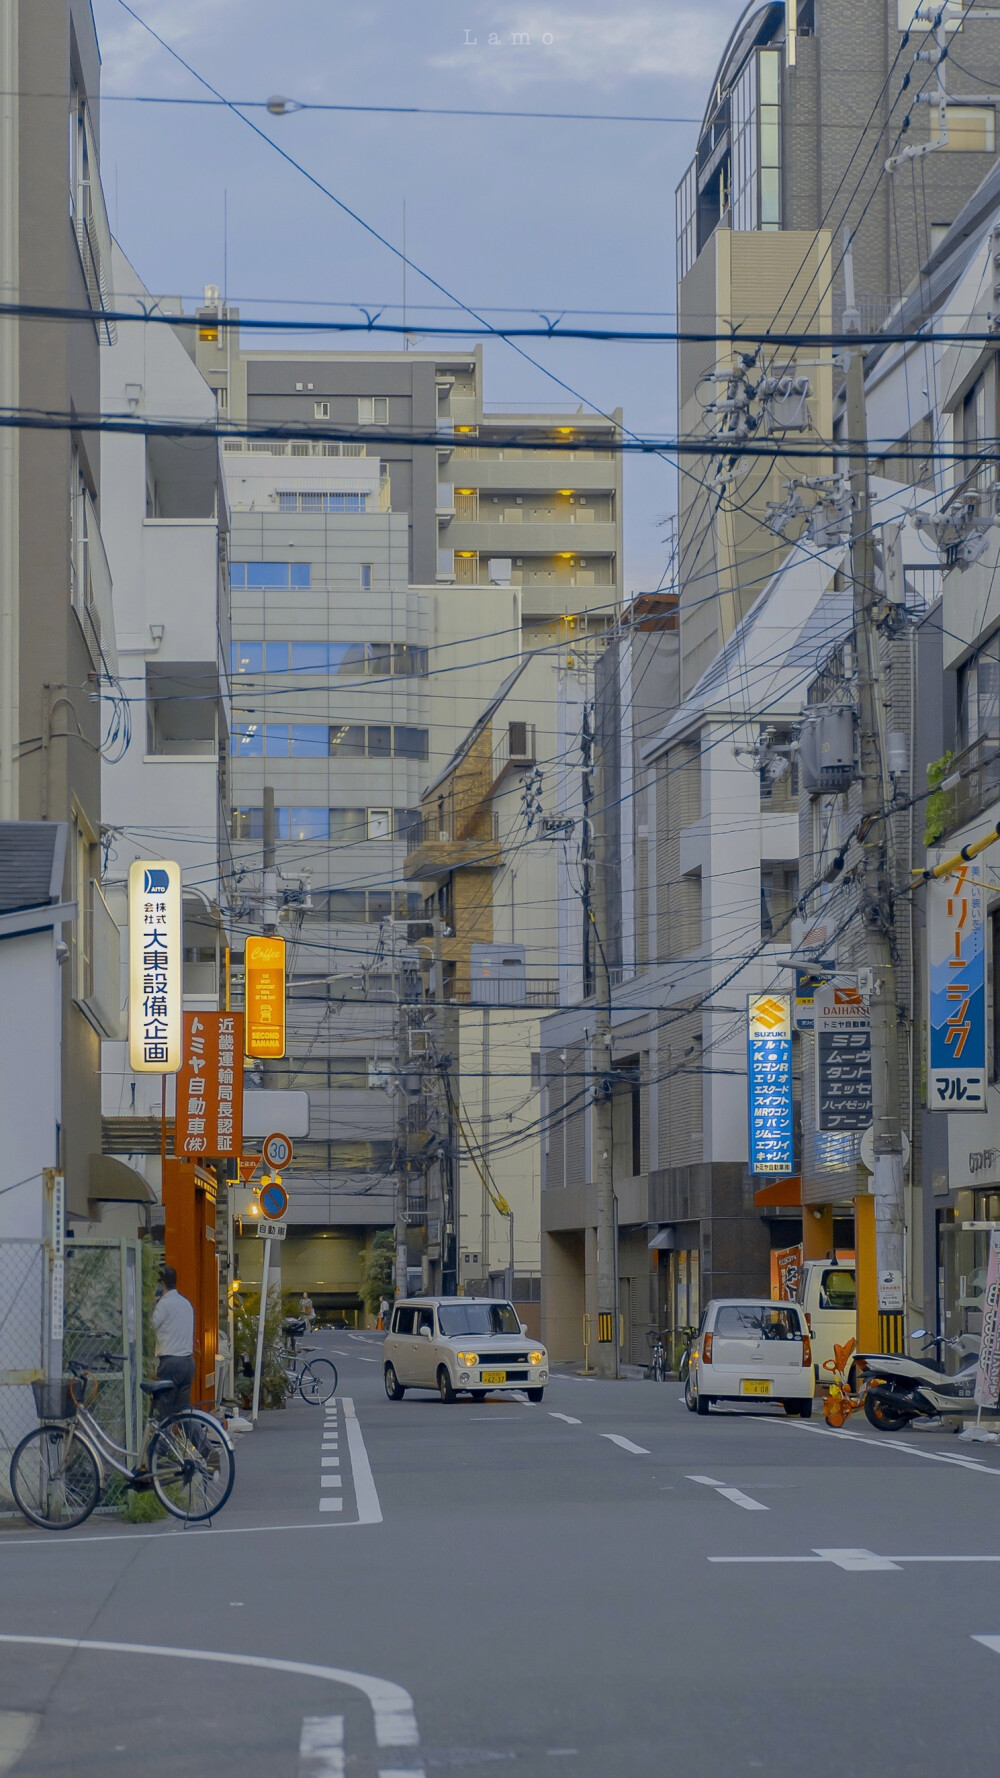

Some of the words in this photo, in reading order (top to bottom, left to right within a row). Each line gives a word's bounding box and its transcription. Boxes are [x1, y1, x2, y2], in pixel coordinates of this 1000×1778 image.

[251, 945, 281, 962] Coffee
[143, 928, 168, 1063] 大東設備企画
[251, 1032, 280, 1040] SECOND
[832, 1034, 867, 1046] ミラ
[753, 1040, 789, 1050] アルト
[753, 1062, 789, 1072] ワゴンR
[826, 1066, 872, 1079] タント
[753, 1074, 789, 1083] エリオ
[217, 1018, 235, 1151] 近畿運輸局長認証
[754, 1085, 790, 1094] エスクード
[827, 1083, 872, 1095] エッセ
[935, 1077, 981, 1101] マルニ
[754, 1096, 790, 1106] スイフト
[822, 1100, 873, 1110] ハイゼット
[754, 1107, 789, 1117] MRワゴン
[754, 1118, 790, 1128] ラパン
[827, 1115, 873, 1127] ブーン
[755, 1130, 791, 1139] ジムニー
[269, 1142, 286, 1160] 30
[259, 1223, 285, 1236] 自動車
